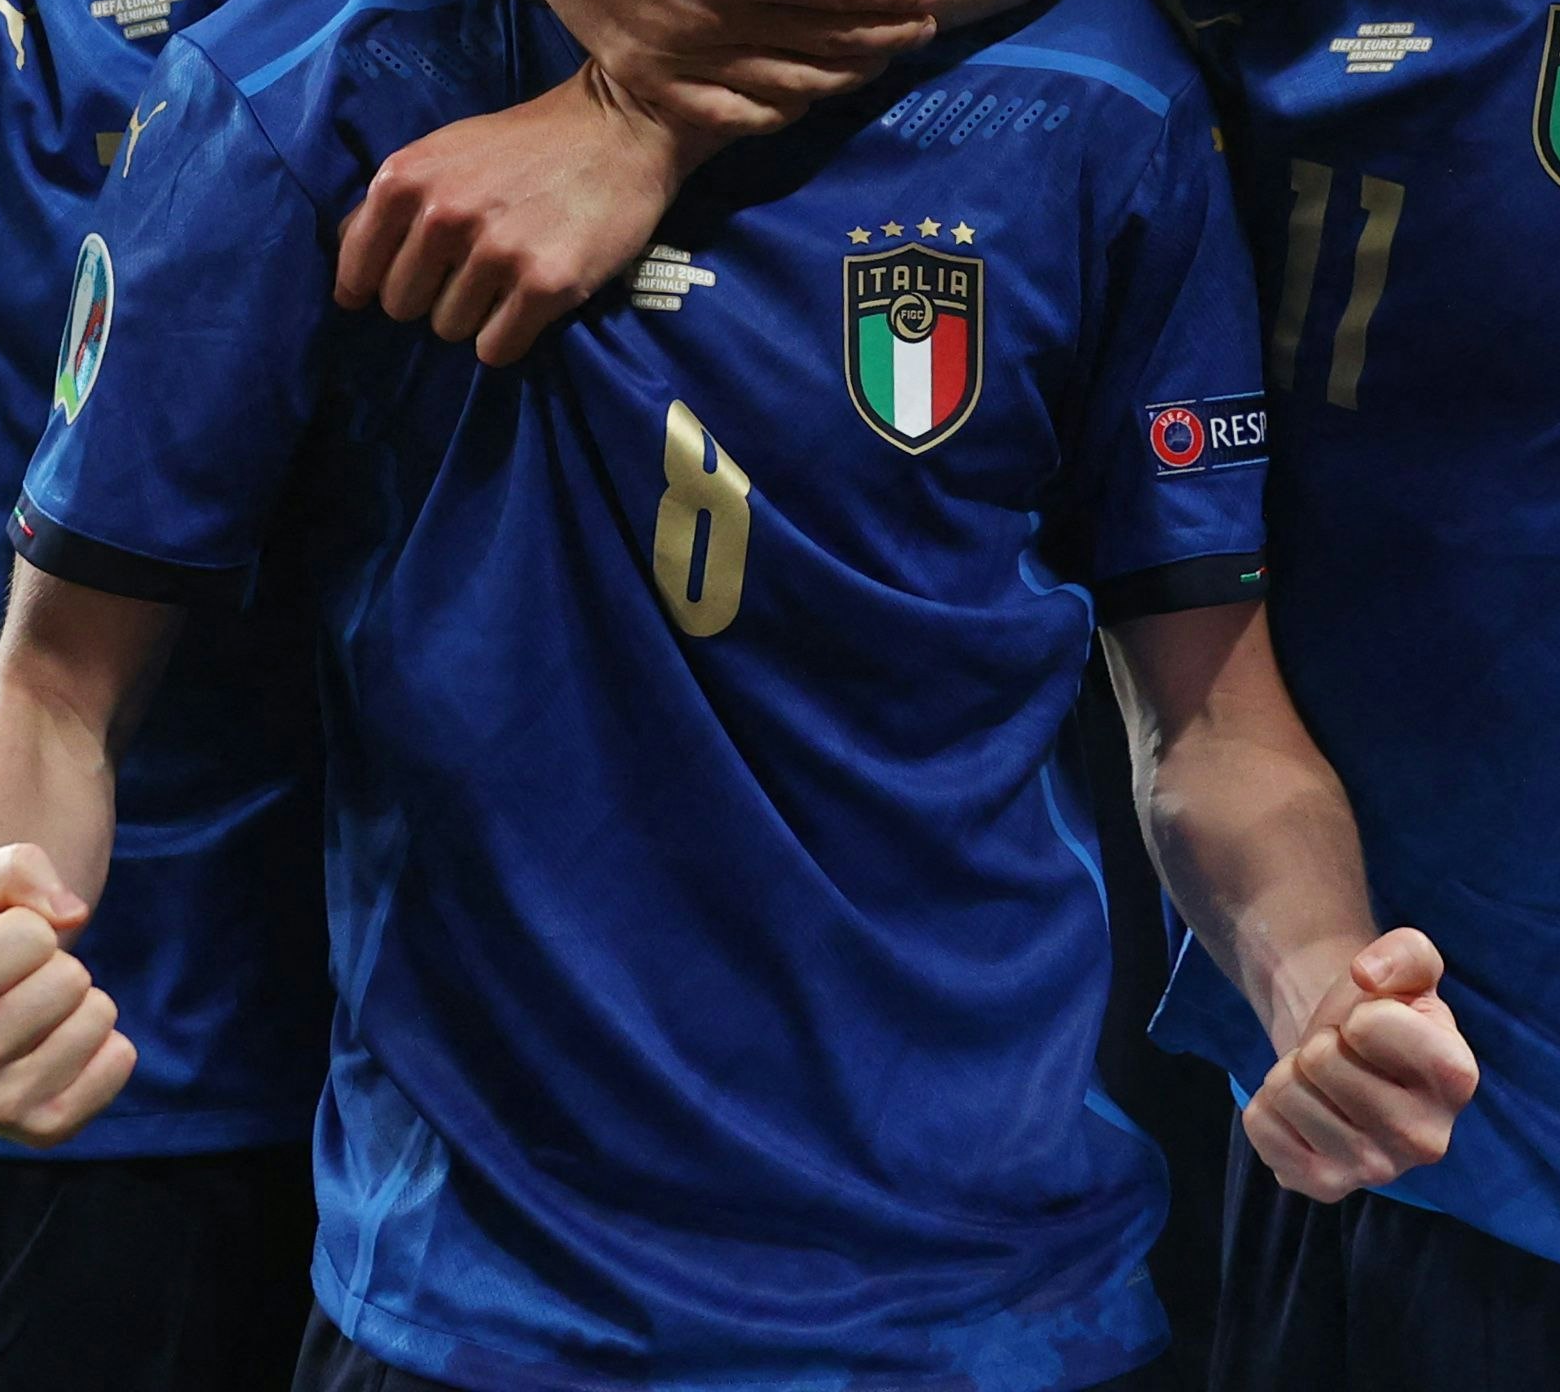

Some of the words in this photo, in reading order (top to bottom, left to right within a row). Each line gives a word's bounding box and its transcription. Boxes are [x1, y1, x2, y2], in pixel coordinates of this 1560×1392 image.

[92, 0, 124, 15] UEFA
[119, 4, 167, 21] SEMIFINALE
[1332, 39, 1361, 50] UEFA
[1364, 39, 1396, 50] EURO
[1398, 38, 1430, 50] 2020
[1350, 50, 1404, 60] SEMIFINALE
[678, 266, 714, 283] 2020
[858, 265, 968, 297] ITALIA
[1269, 158, 1406, 410] 11
[901, 309, 924, 320] FIGC
[1159, 411, 1191, 427] UEFA
[653, 399, 751, 638] 8
